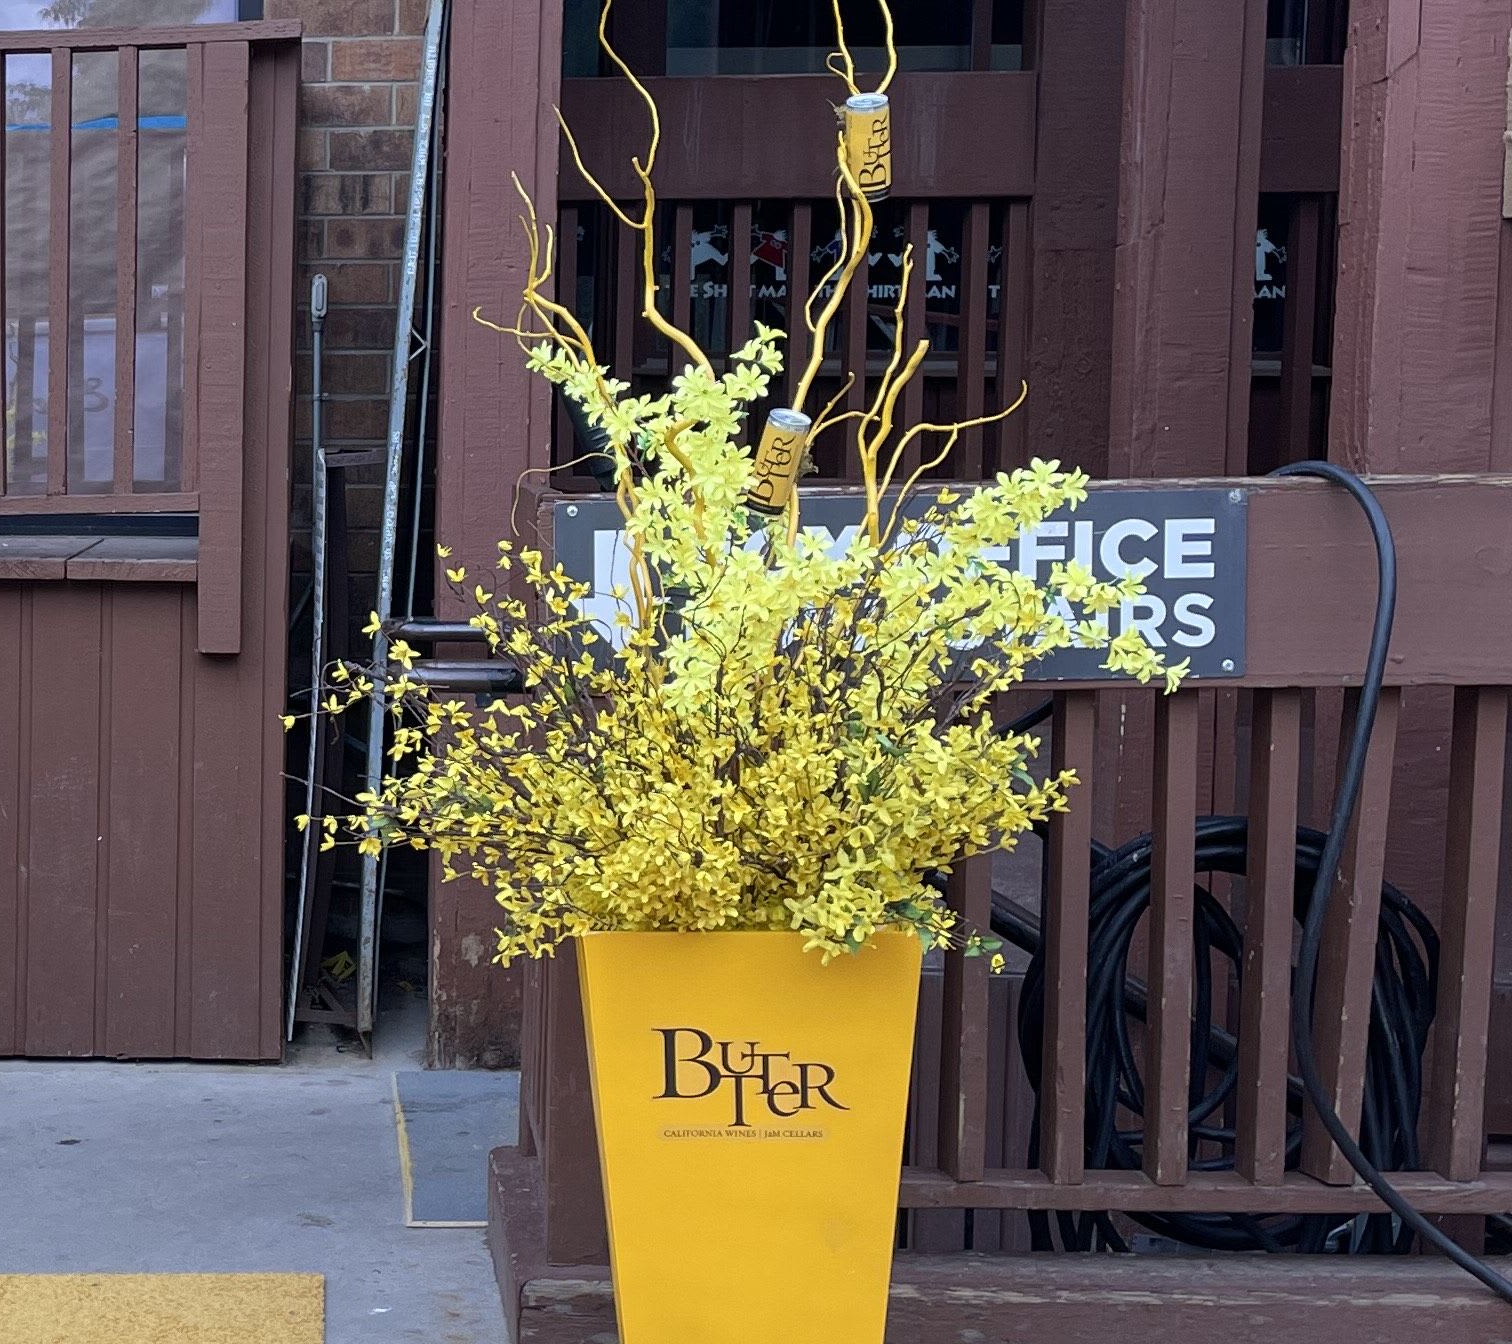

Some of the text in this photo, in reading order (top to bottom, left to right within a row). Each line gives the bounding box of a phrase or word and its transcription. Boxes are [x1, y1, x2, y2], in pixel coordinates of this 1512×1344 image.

[758, 284, 787, 298] MA
[867, 284, 902, 298] HIRT
[925, 284, 956, 298] AN
[1255, 284, 1286, 298] AN
[663, 1129, 723, 1138] CALIFORNIA
[724, 1129, 757, 1138] WINES
[782, 1129, 823, 1138] CELLARS
